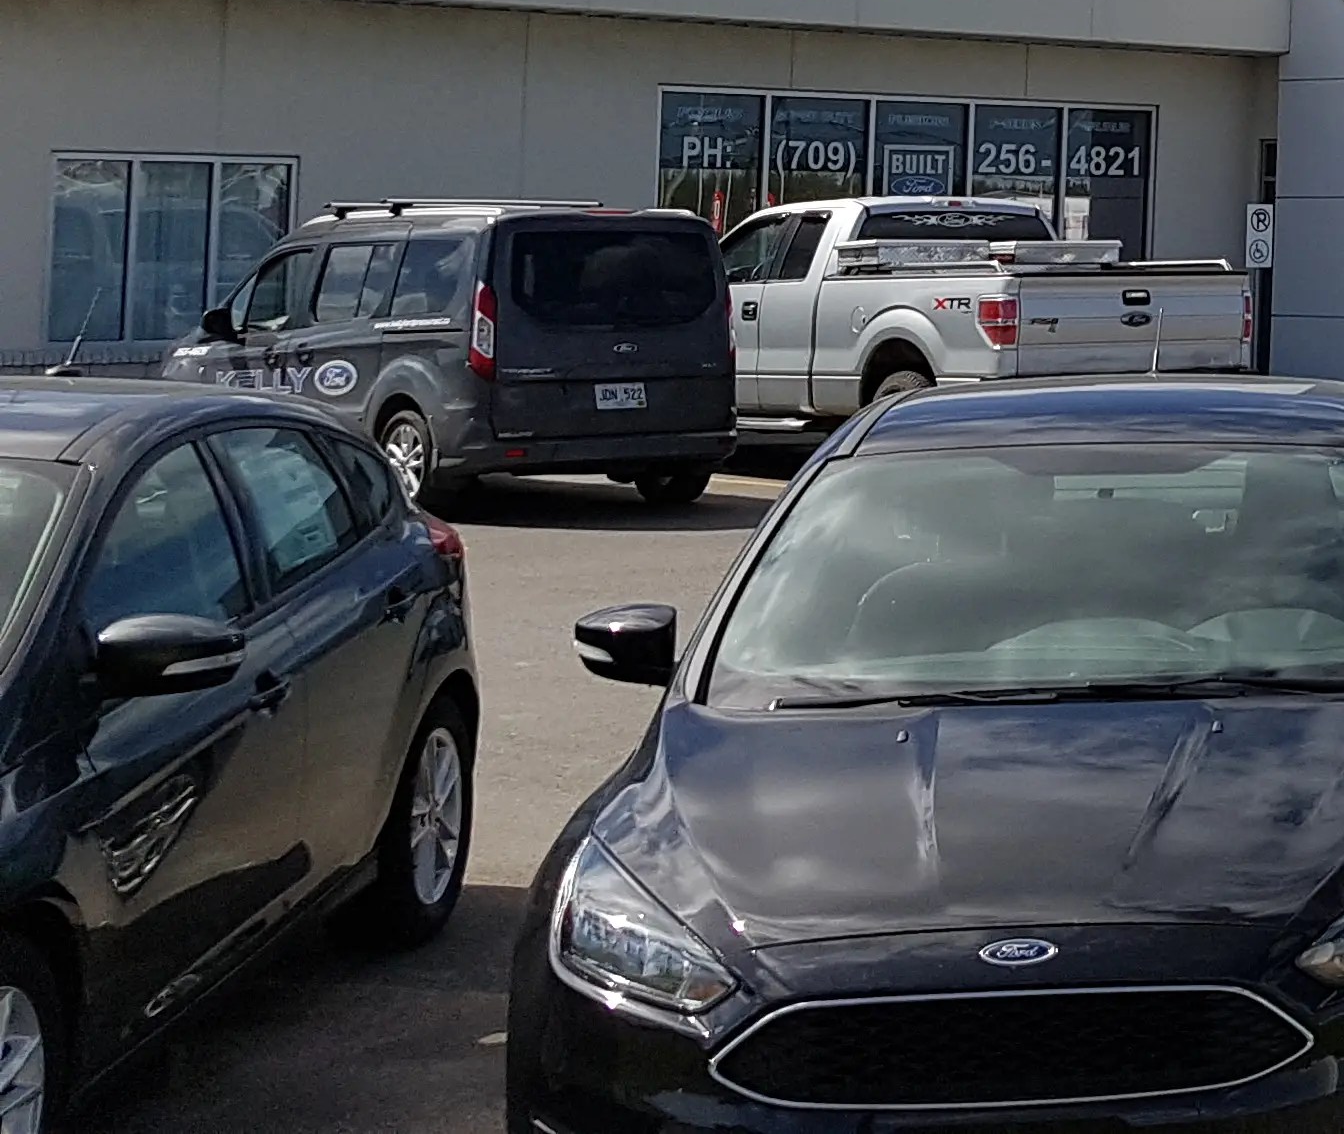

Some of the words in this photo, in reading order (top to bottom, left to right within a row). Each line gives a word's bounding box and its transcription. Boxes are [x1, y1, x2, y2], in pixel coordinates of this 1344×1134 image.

[682, 136, 732, 168] PH:
[776, 138, 857, 179] (709)
[1069, 145, 1141, 176] 4821
[891, 153, 946, 174] BUILT
[932, 297, 972, 310] XTR
[213, 365, 316, 395] KELLY
[623, 386, 644, 401] 522
[996, 943, 1040, 959] Ford
